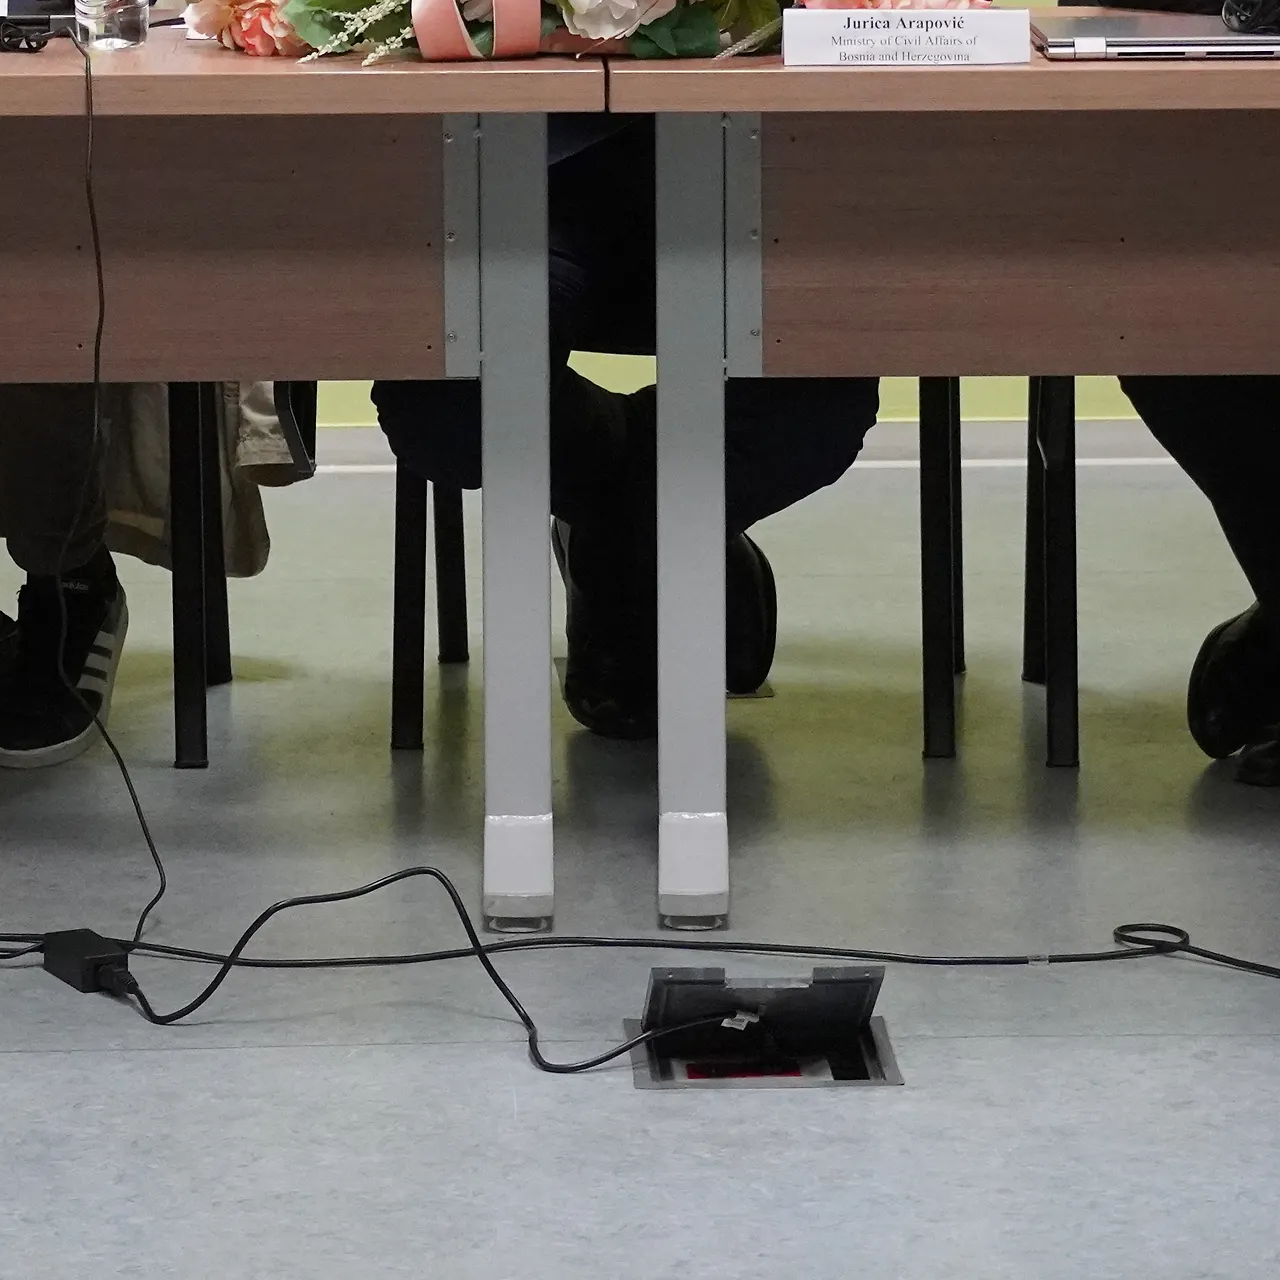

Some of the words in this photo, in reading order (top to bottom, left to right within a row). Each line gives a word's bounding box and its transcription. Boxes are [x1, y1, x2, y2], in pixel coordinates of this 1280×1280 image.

[844, 16, 890, 29] Jurica
[896, 16, 964, 32] Arapović
[831, 36, 876, 48] Ministry
[880, 35, 893, 46] of
[894, 35, 921, 46] Civil
[926, 35, 962, 46] Affairs
[966, 35, 978, 46] of
[839, 51, 875, 61] Bosnia
[879, 51, 898, 61] and
[902, 51, 970, 63] Herzegovina
